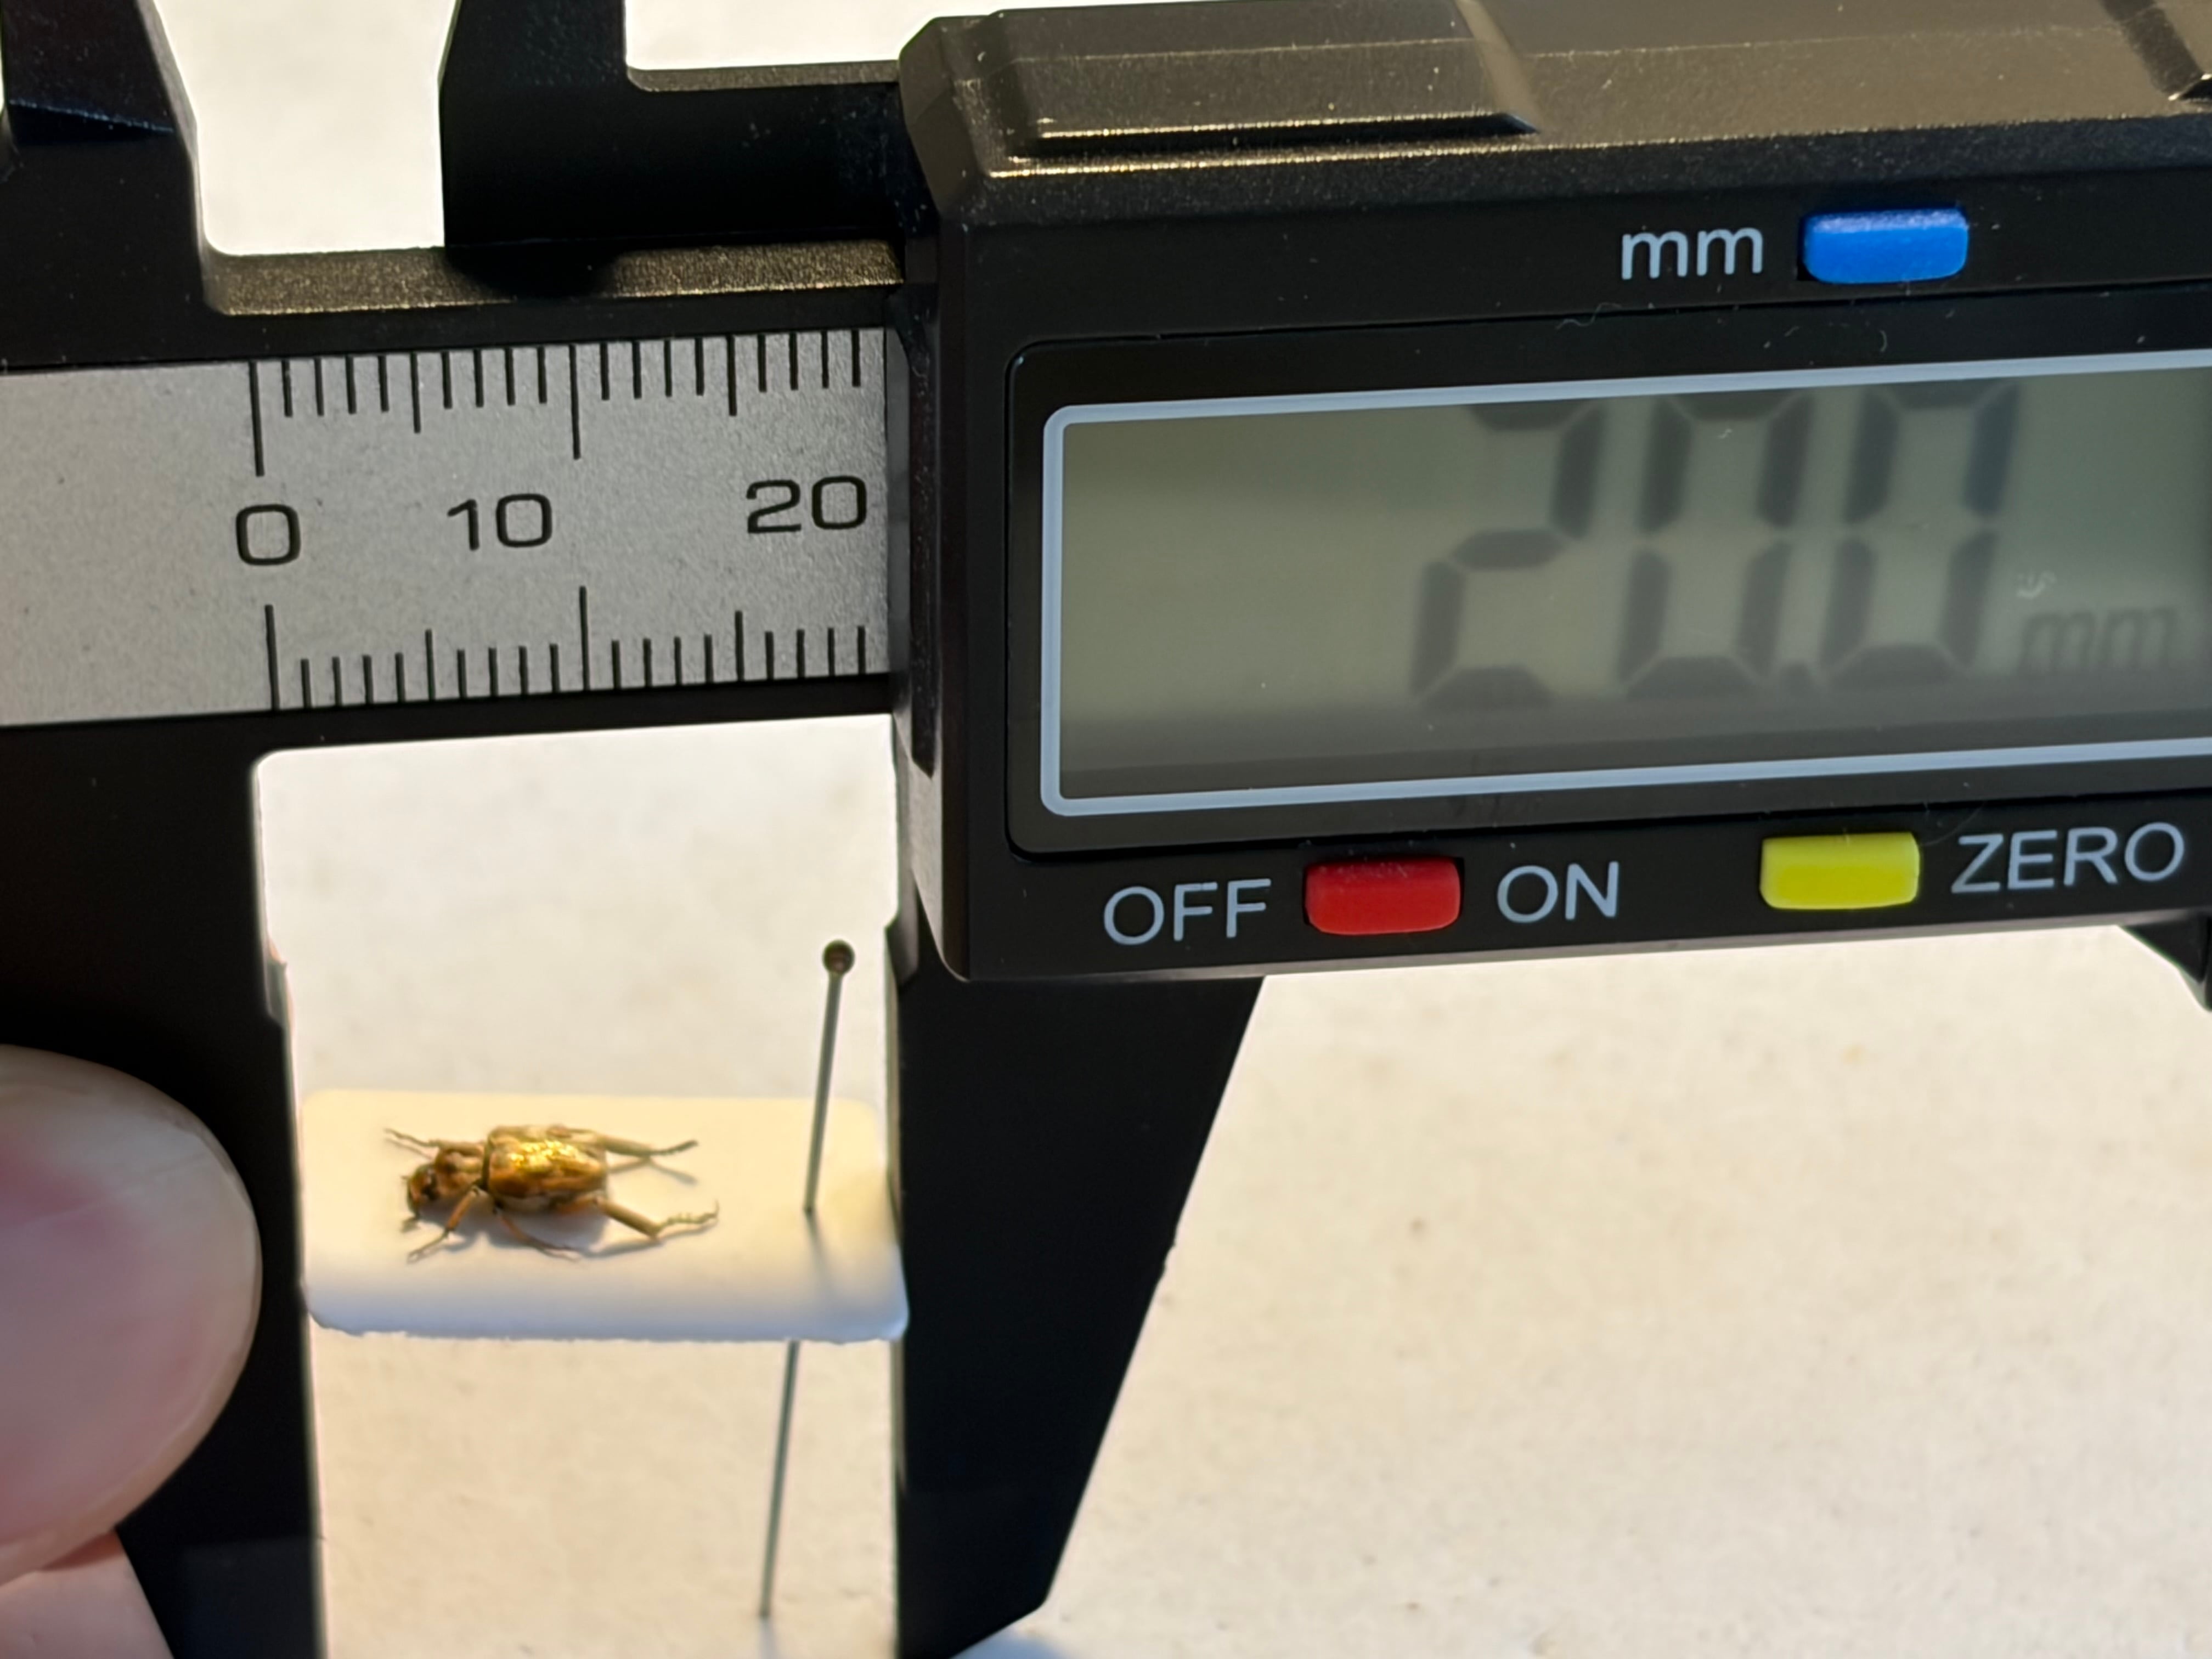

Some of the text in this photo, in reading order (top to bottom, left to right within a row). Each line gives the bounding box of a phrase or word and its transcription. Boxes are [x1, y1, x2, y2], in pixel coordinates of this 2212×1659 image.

[1621, 227, 1763, 280] mm
[235, 475, 868, 566] 0 10 20
[1408, 381, 2178, 711] 20.0 mm
[1497, 860, 1620, 924] ON
[1950, 821, 2185, 894] ZERO
[1103, 878, 1272, 945] OFF
